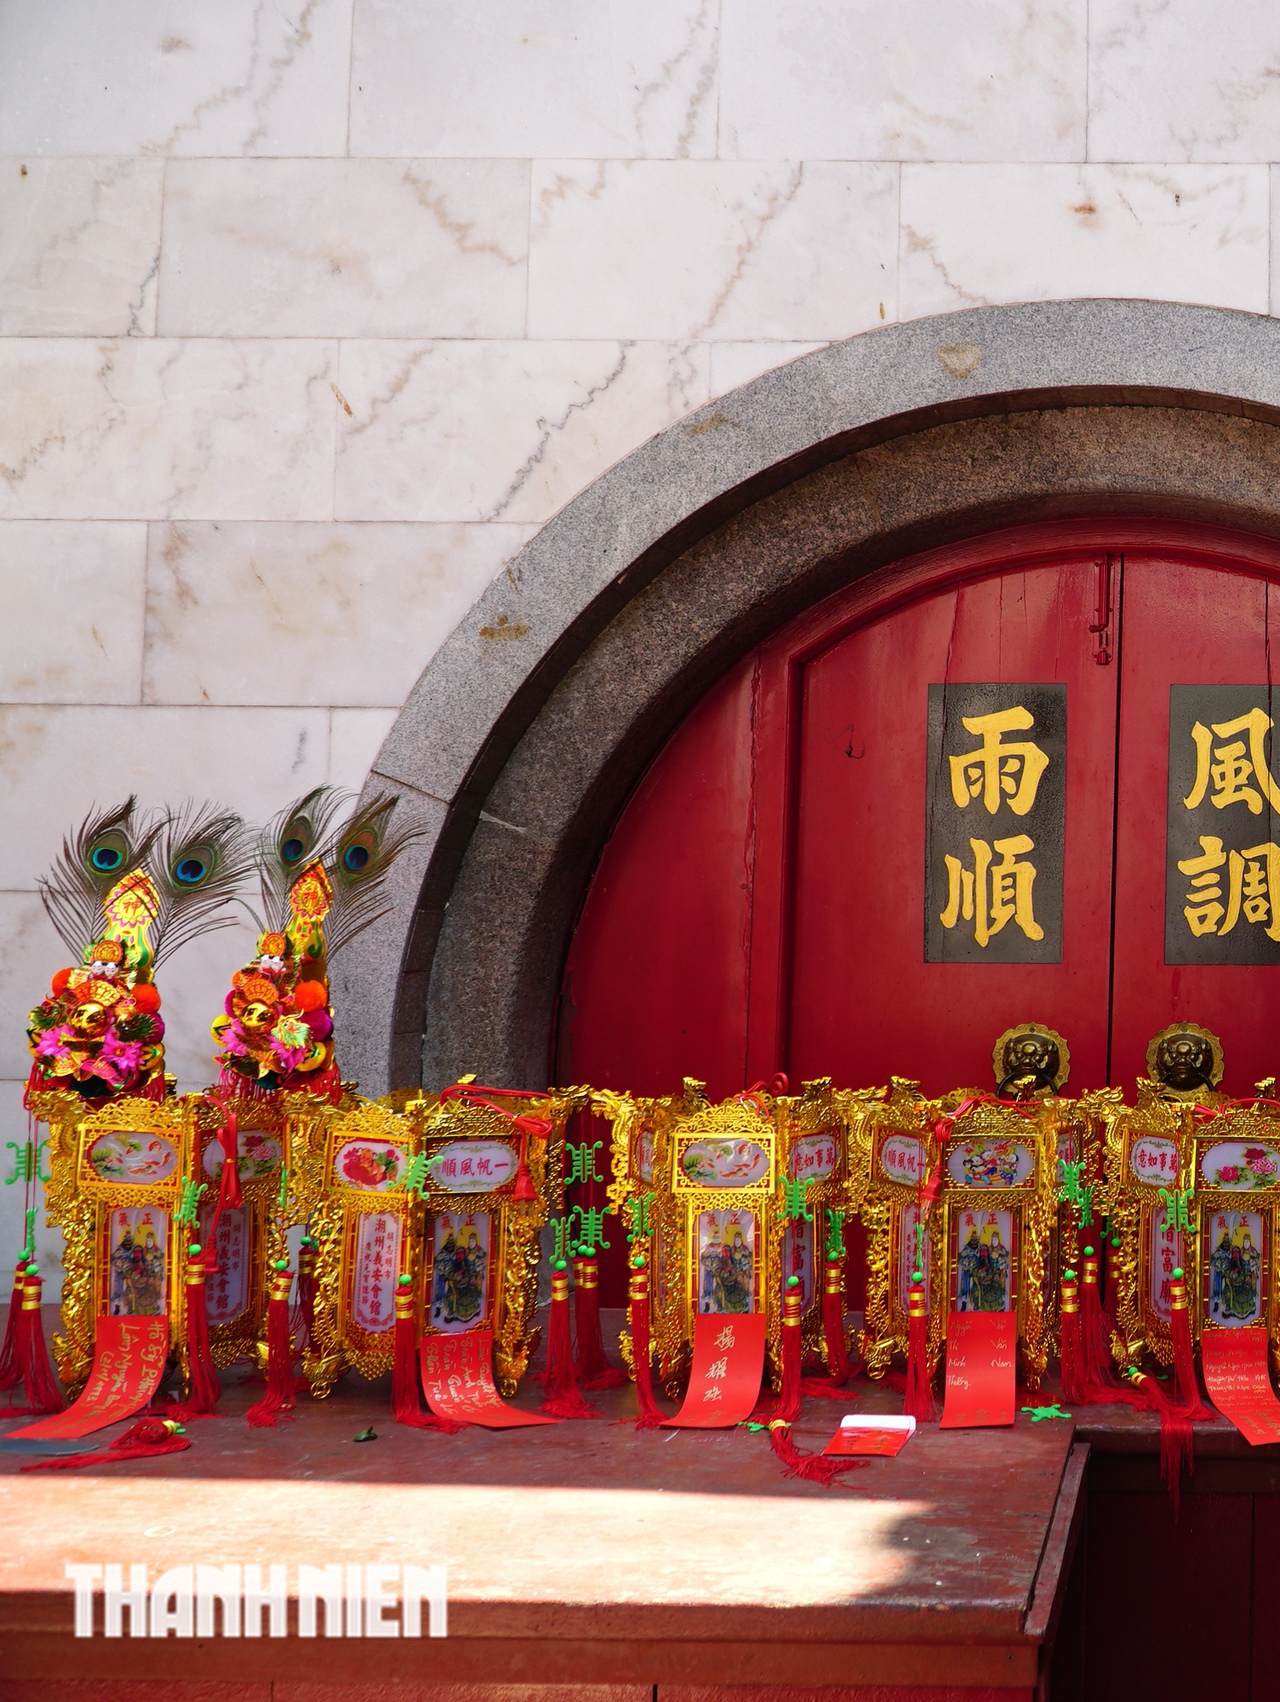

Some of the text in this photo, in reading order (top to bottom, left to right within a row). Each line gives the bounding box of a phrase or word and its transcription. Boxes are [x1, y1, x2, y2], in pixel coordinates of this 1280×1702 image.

[940, 706, 1049, 947] 雨順
[123, 898, 140, 918] 神
[368, 1218, 386, 1316] 潮州義安會館
